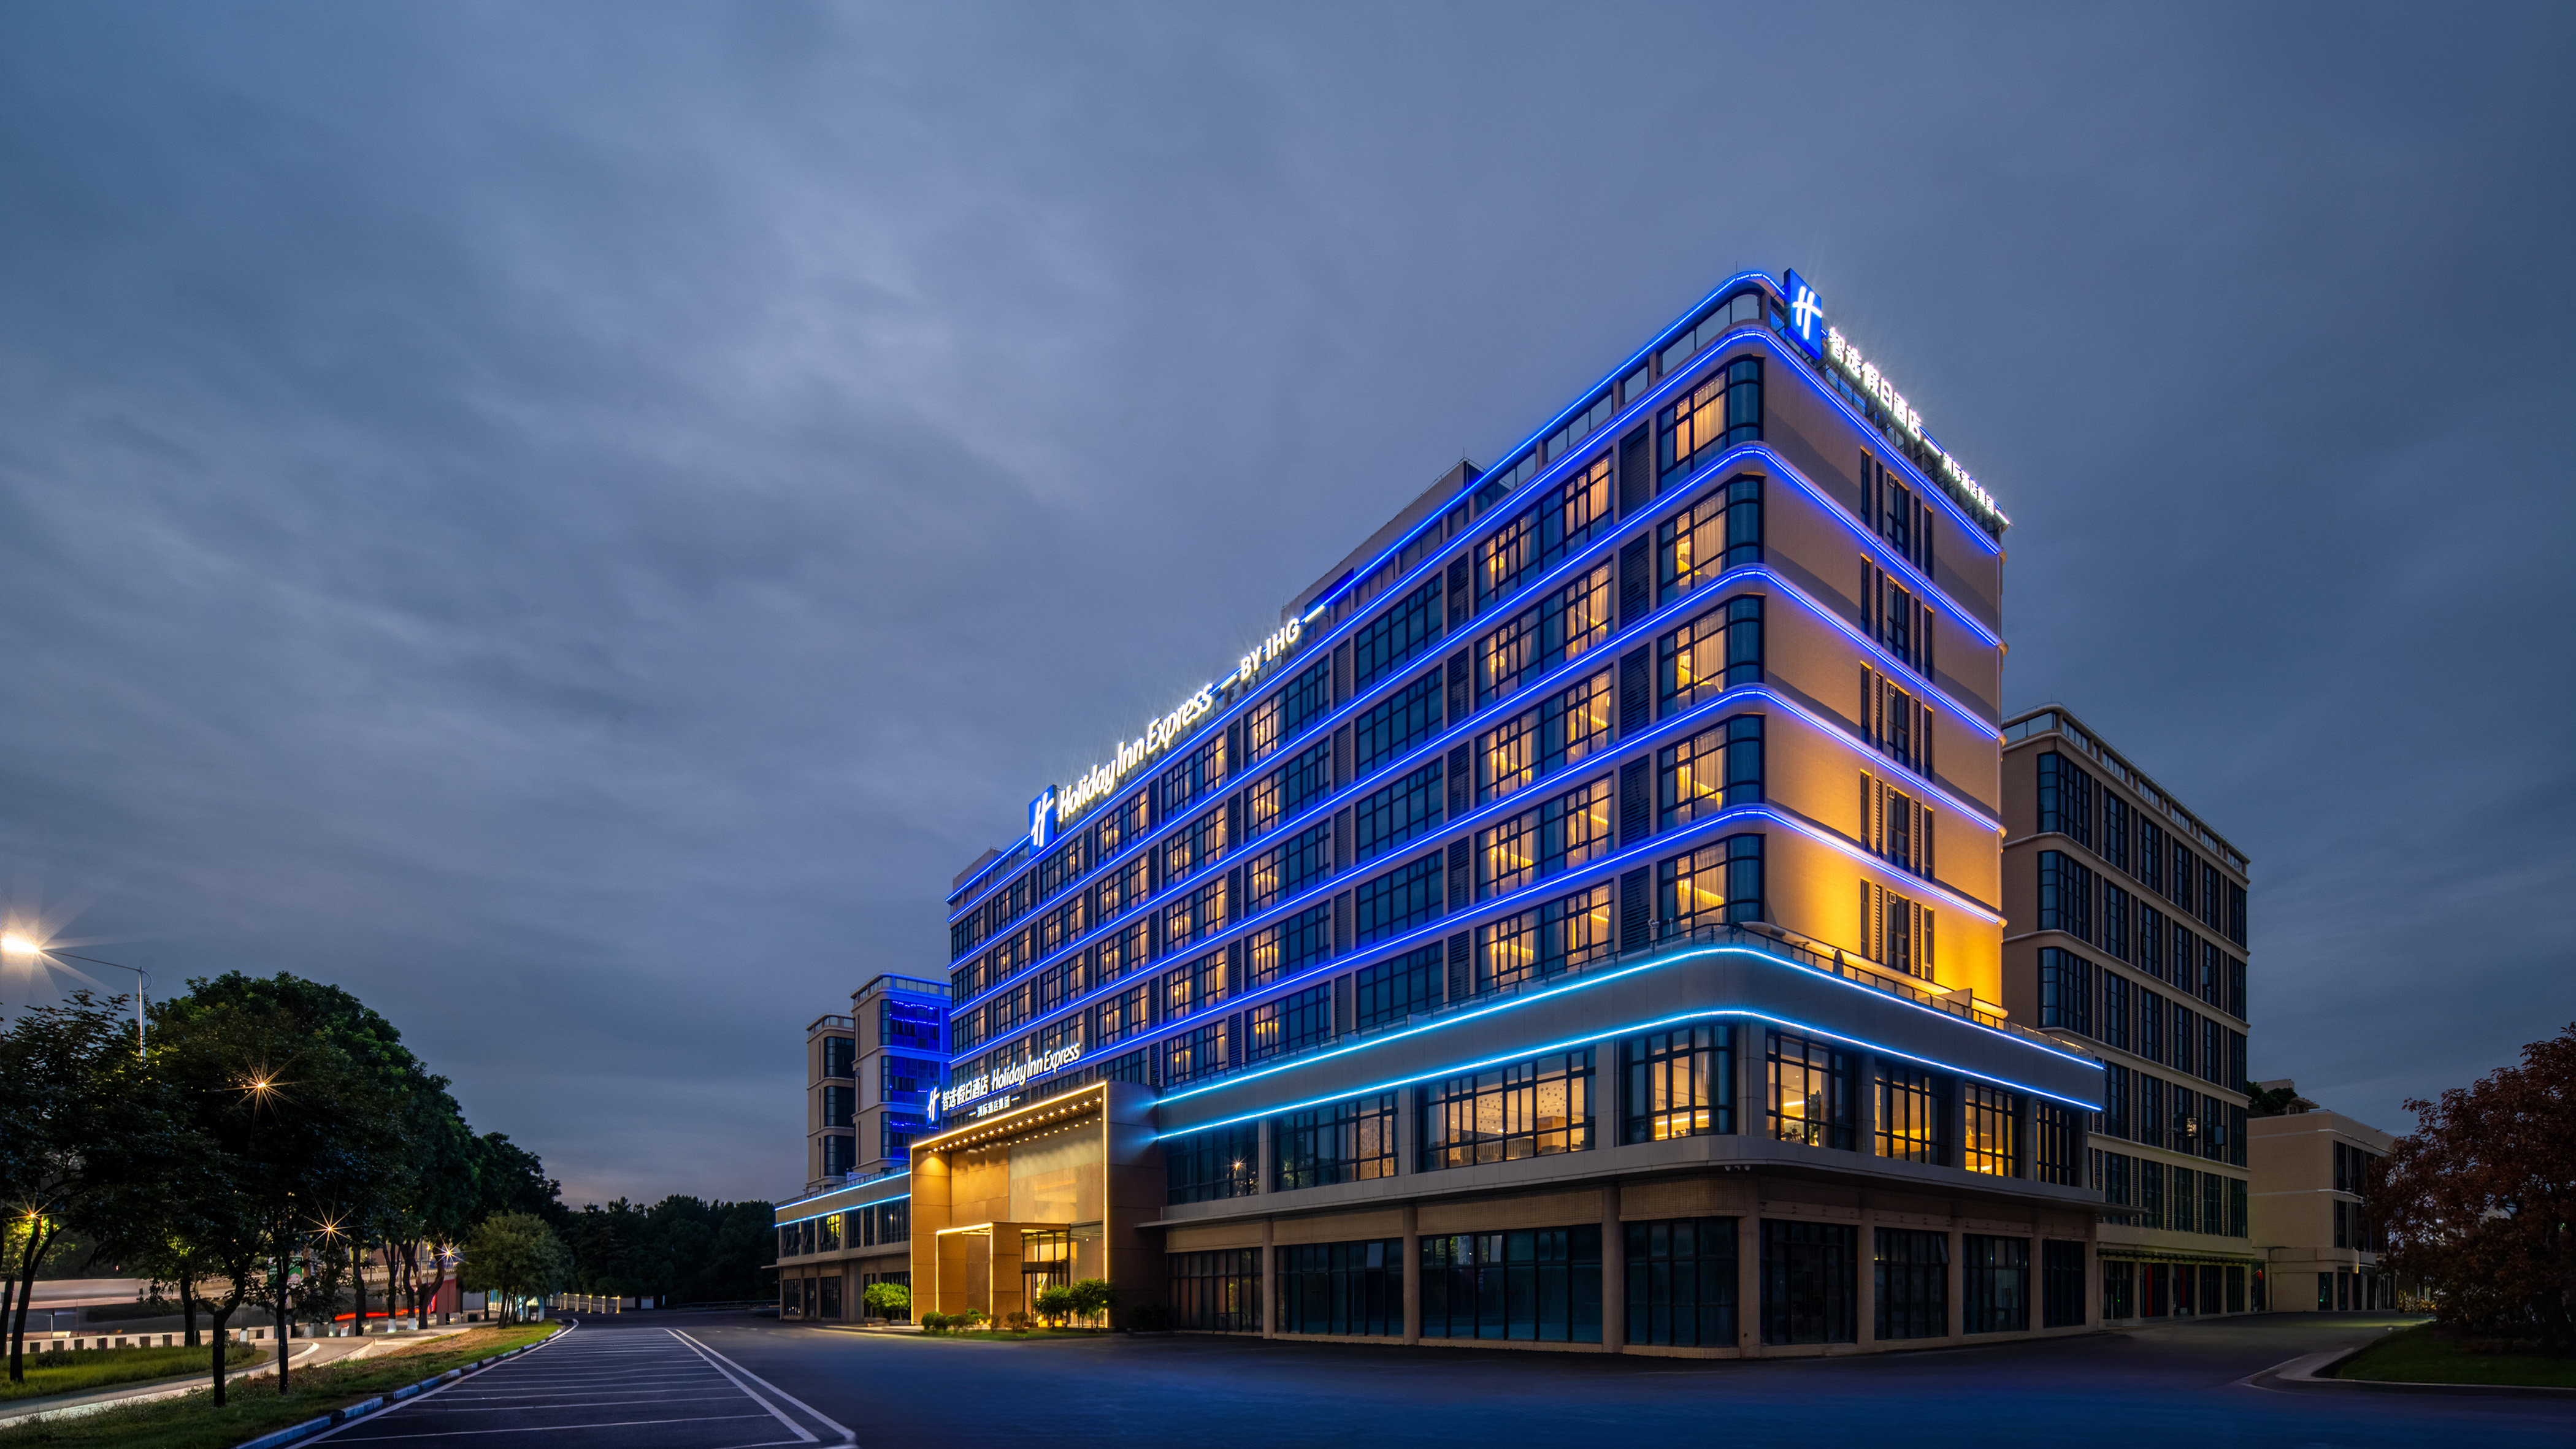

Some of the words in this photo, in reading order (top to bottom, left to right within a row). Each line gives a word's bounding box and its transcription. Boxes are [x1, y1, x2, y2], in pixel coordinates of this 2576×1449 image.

[1828, 327, 1922, 442] 智选假日酒店
[1057, 760, 1117, 822] Holiday
[1117, 738, 1145, 778] Inn
[1146, 682, 1214, 754] Express
[1240, 645, 1263, 680] BY
[1265, 617, 1300, 661] IHG
[941, 1074, 989, 1112] 智选假日酒店
[991, 1061, 1027, 1092] Holiday
[1026, 1054, 1044, 1078] Inn
[1043, 1042, 1081, 1073] Express
